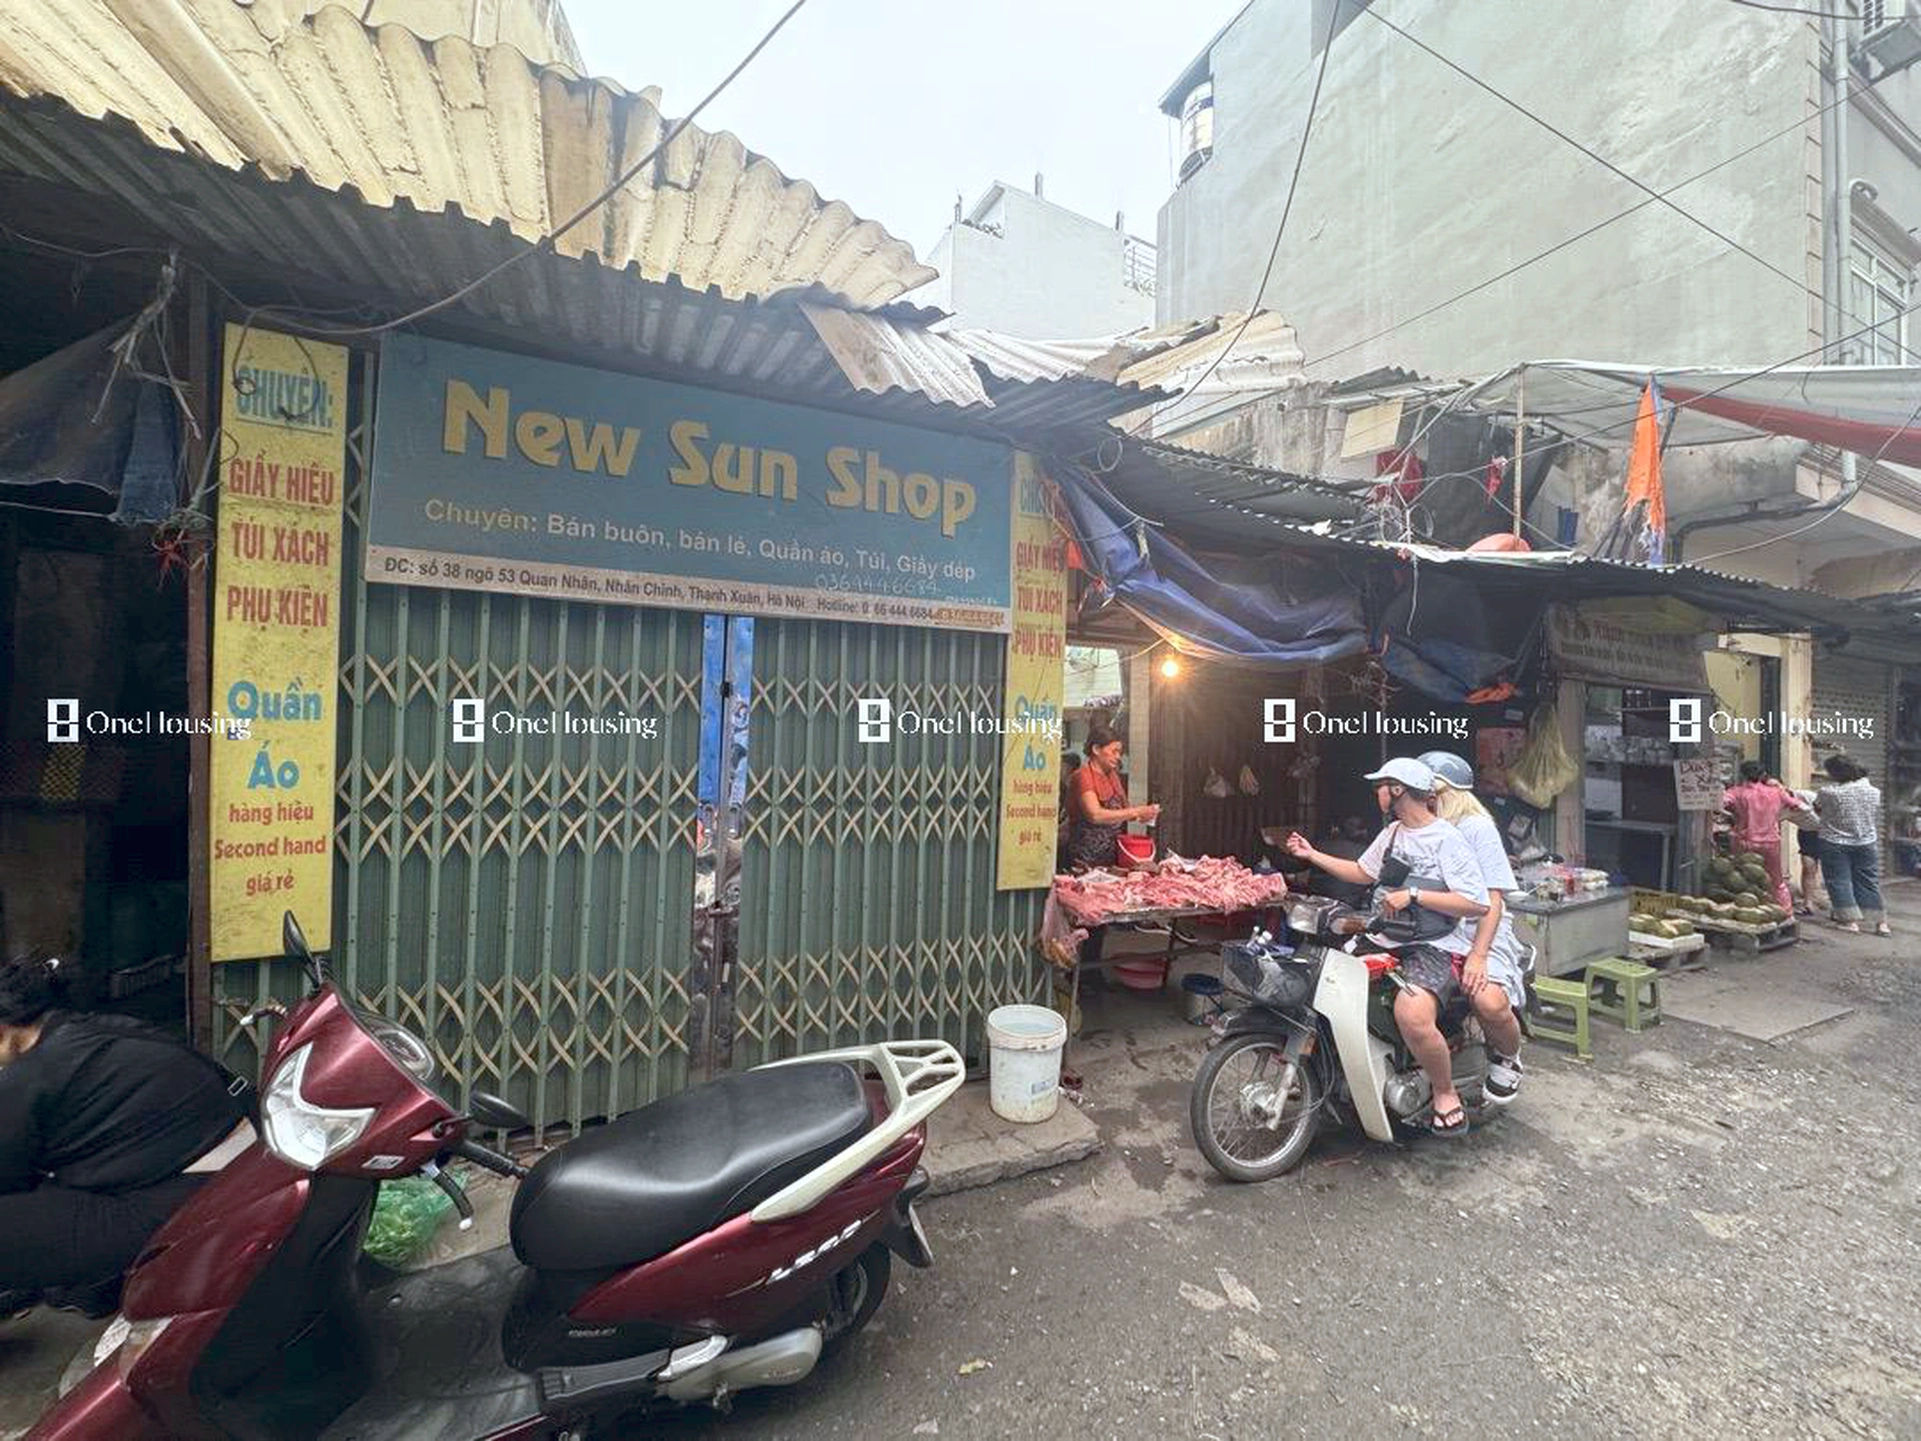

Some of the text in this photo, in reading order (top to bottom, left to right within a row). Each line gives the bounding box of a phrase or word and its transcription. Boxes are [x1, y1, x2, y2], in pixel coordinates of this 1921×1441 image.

[444, 379, 977, 539] New Sun Shop
[285, 460, 336, 511] HIỆU
[231, 515, 329, 567] TÚI XÁCH
[425, 499, 538, 533] Chuyên:
[547, 513, 596, 538] Bán
[604, 521, 671, 549] buôn,
[679, 529, 720, 553] bán
[385, 556, 415, 574] ĐC:
[418, 557, 439, 577] số
[442, 563, 461, 578] 38
[464, 565, 494, 584] ngõ
[498, 568, 515, 582] 53
[519, 569, 557, 588] Quan
[560, 573, 601, 592] Nhân,
[604, 578, 641, 595] Nhân
[688, 585, 727, 602] Thanh
[227, 583, 328, 634] PHỤ KIỆN
[227, 677, 322, 721] Quần
[247, 740, 299, 789] Áo
[1023, 736, 1046, 769] Áo
[229, 802, 272, 825] hàng
[215, 835, 327, 859] Second hand
[246, 870, 272, 896] giá
